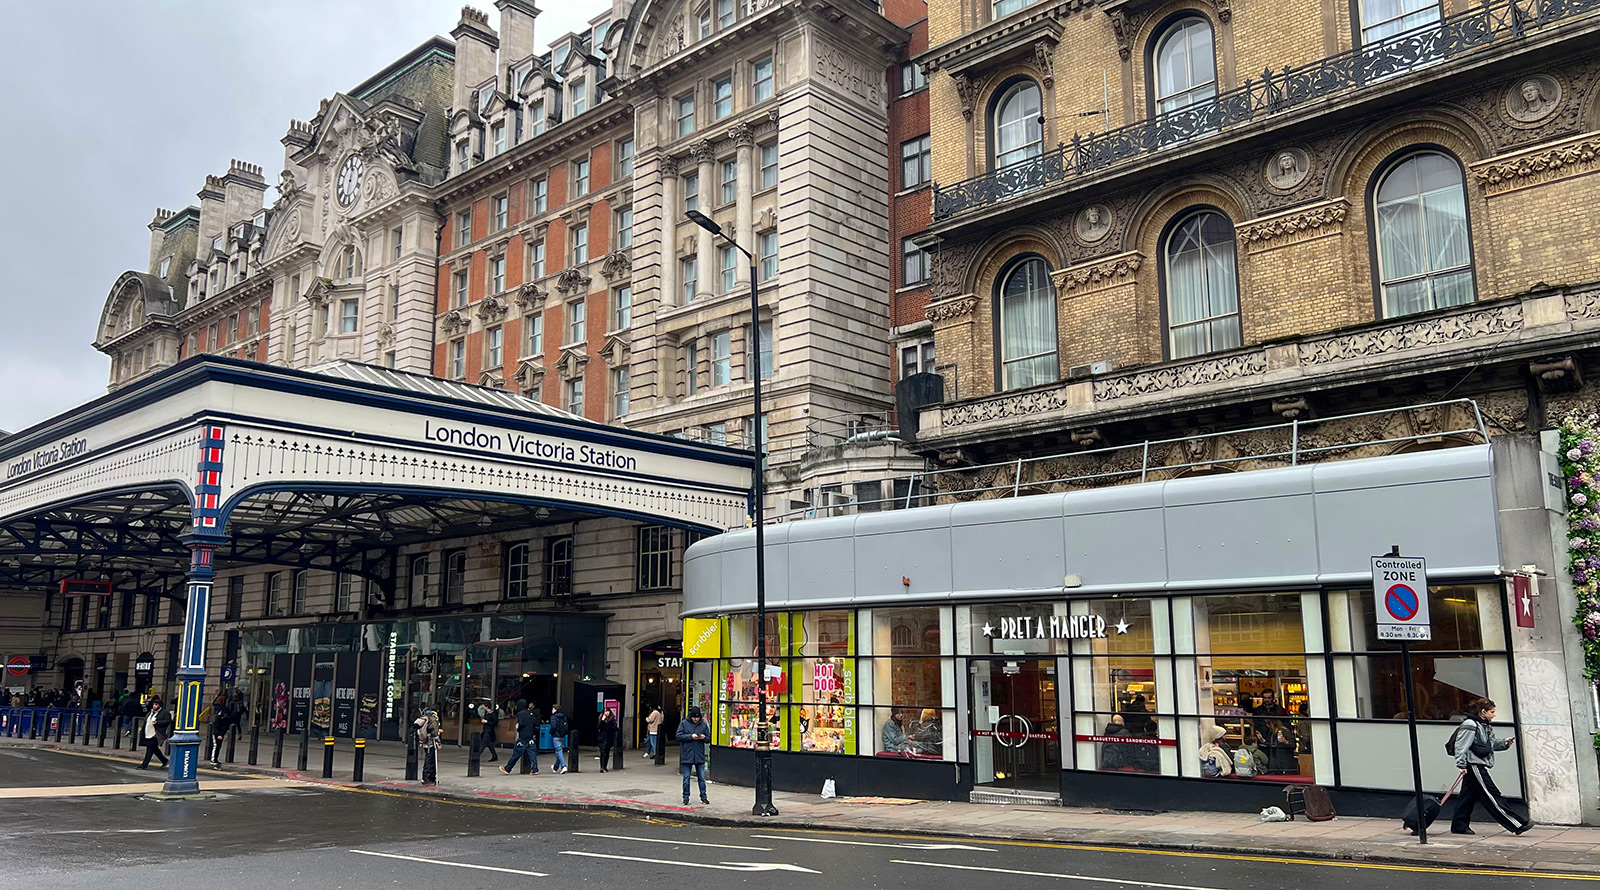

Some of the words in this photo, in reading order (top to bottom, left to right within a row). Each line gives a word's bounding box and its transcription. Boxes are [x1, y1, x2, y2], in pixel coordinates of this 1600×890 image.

[7, 456, 32, 479] London
[33, 446, 59, 469] Victoria
[59, 437, 87, 460] Station
[425, 420, 501, 450] London
[507, 433, 575, 462] Victoria
[579, 445, 637, 470] Station
[1375, 560, 1422, 569] Controlled
[1383, 571, 1416, 581] ZONE
[689, 621, 718, 655] scribbler
[1001, 616, 1032, 639] PRET
[1037, 616, 1045, 639] A
[1049, 614, 1106, 639] MANGER
[387, 631, 397, 684] STARBUCKS
[814, 665, 834, 677] HOT
[385, 685, 394, 719] COFFEE
[814, 680, 835, 691] DOG
[844, 670, 856, 735] scribbler
